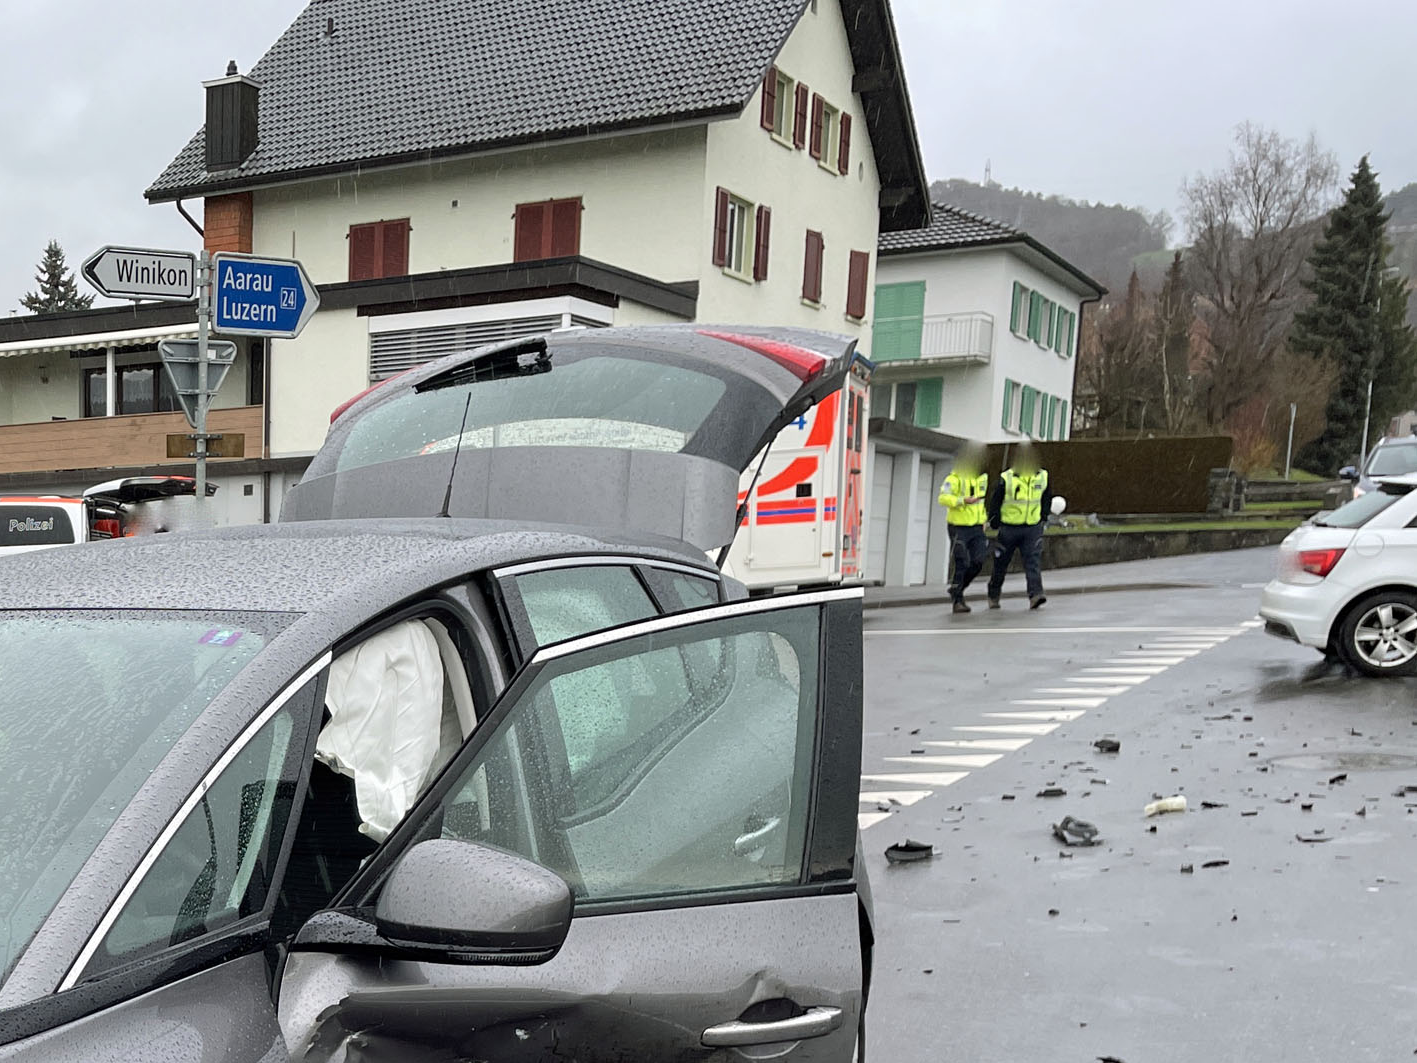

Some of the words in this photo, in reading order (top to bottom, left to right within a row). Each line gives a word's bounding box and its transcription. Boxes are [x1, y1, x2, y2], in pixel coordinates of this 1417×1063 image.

[116, 258, 187, 287] Winikon
[222, 265, 272, 292] Aarau
[222, 296, 276, 323] Luzern
[282, 290, 294, 307] 24
[8, 517, 54, 532] Polizei
